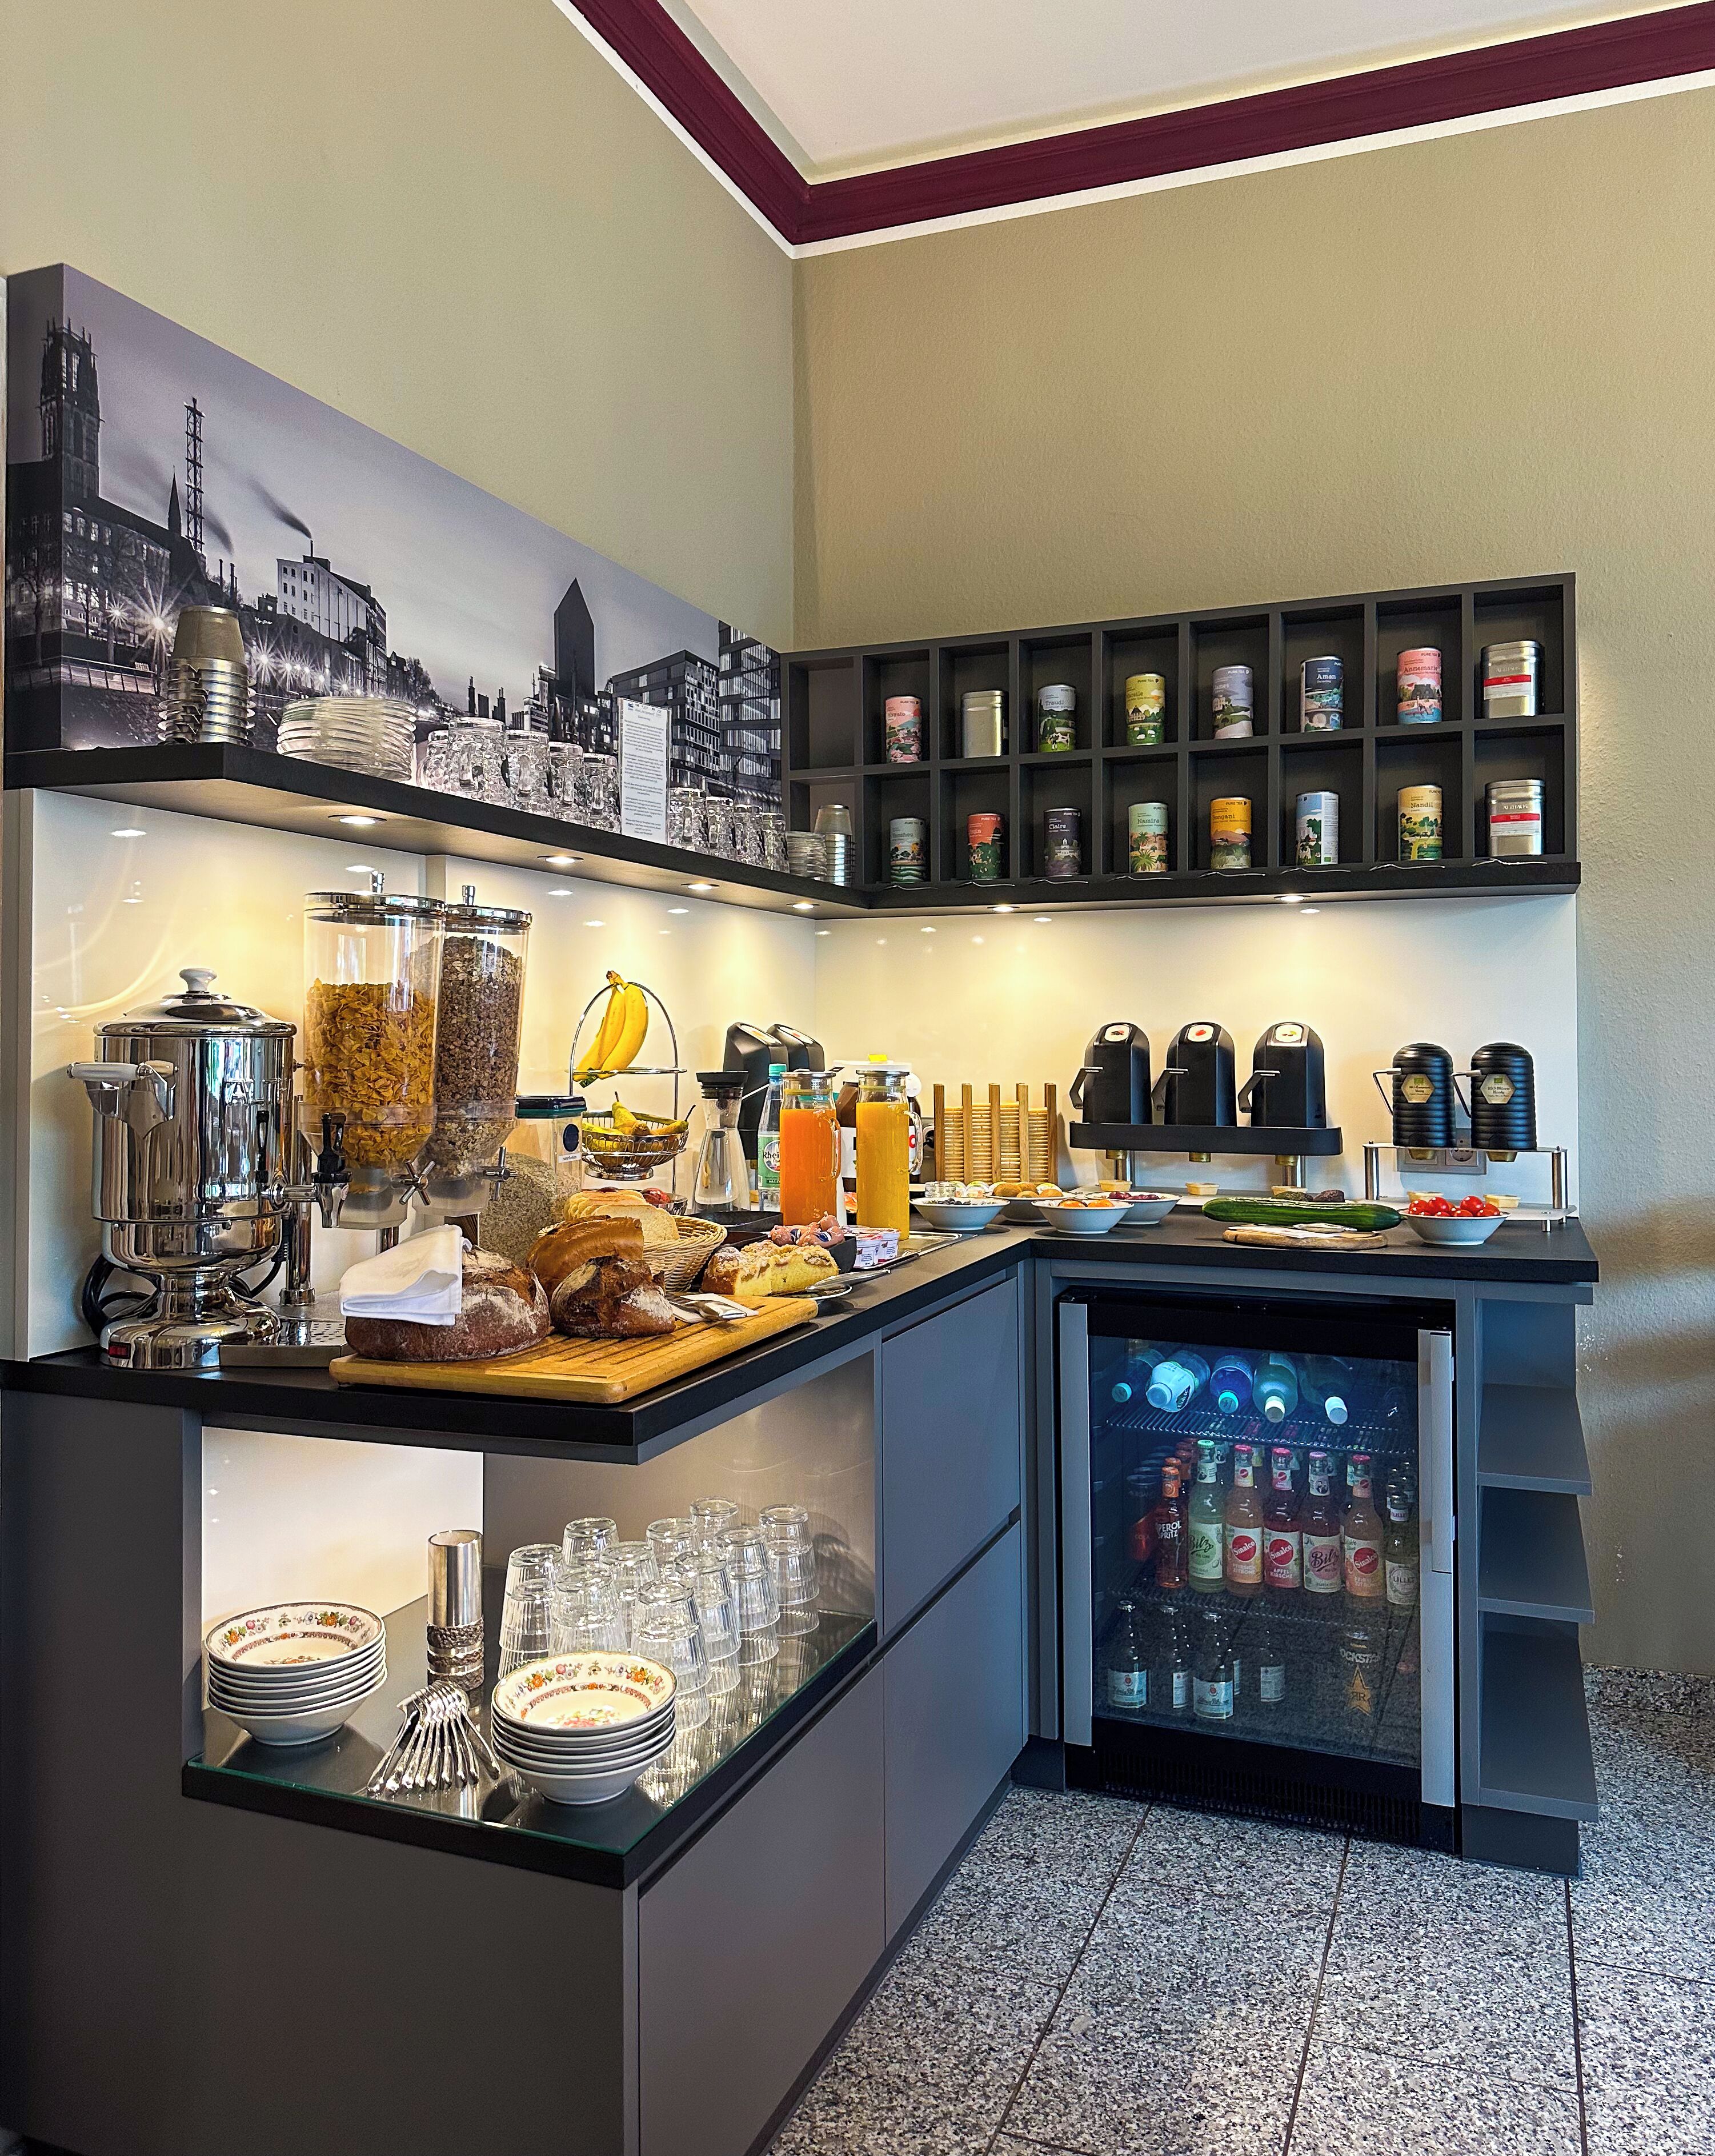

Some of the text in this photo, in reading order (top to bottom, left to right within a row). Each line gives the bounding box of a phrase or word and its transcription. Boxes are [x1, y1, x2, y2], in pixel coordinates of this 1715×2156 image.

[763, 1151, 780, 1159] Rhei
[1233, 1541, 1255, 1555] Sinalco
[1271, 1545, 1292, 1559] Sinalco
[1355, 1552, 1378, 1569] Sinalco
